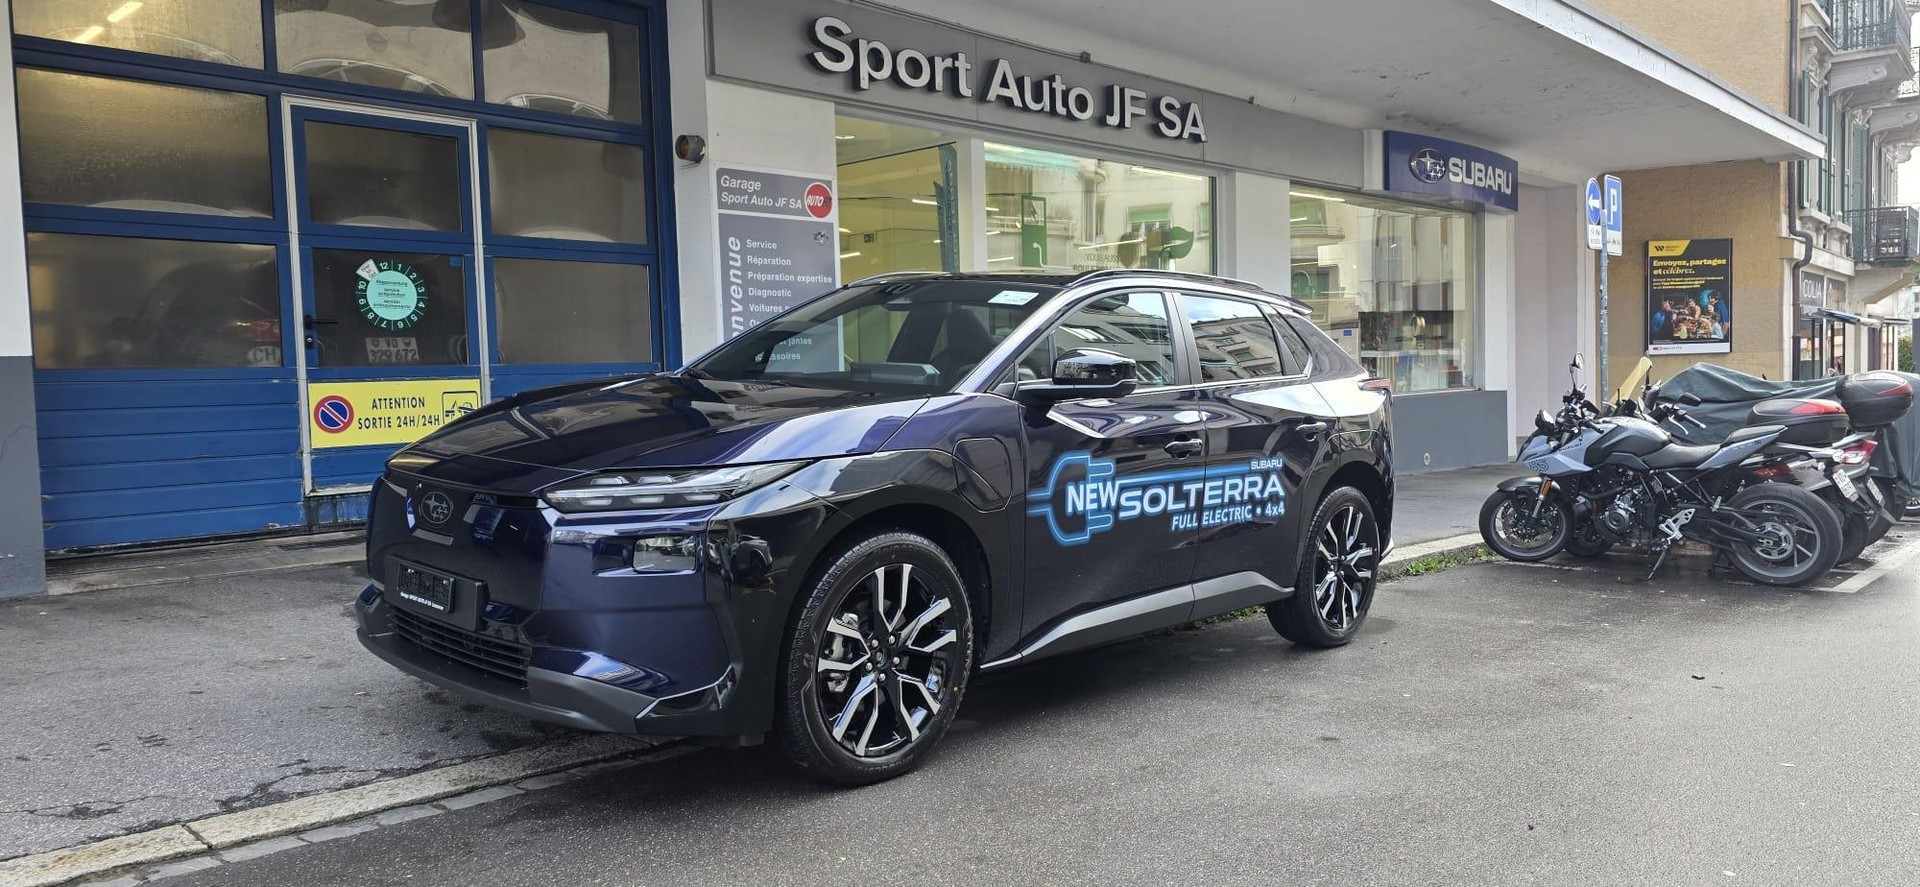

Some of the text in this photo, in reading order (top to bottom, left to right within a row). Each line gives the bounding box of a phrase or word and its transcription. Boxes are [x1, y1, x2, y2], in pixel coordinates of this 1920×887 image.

[812, 16, 1208, 142] Sport Auto JF SA
[1449, 157, 1512, 195] SUBARU
[720, 175, 761, 192] Garage
[721, 192, 802, 209] Sport Auto JF SA
[1610, 188, 1618, 225] P
[746, 239, 777, 249] Service
[380, 262, 389, 270] 12
[747, 255, 791, 266] Réparation
[1653, 258, 1727, 267] Envoyez, partagez
[409, 272, 417, 280] 2
[747, 271, 833, 284] Préparation expertise
[358, 280, 367, 290] 10
[748, 287, 792, 298] Diagnostic
[748, 303, 783, 312] Voitures
[367, 312, 375, 320] 8
[384, 338, 399, 348] VD
[788, 337, 812, 347] jantes
[253, 349, 276, 363] CH
[372, 396, 425, 410] ATTENTION
[358, 415, 440, 430] SORTIE 24H/24H
[1250, 459, 1283, 470] SUBARU
[1066, 474, 1286, 520] NEW SOLTERRA
[1171, 502, 1285, 531] FULL ELECTRIC 4x4
